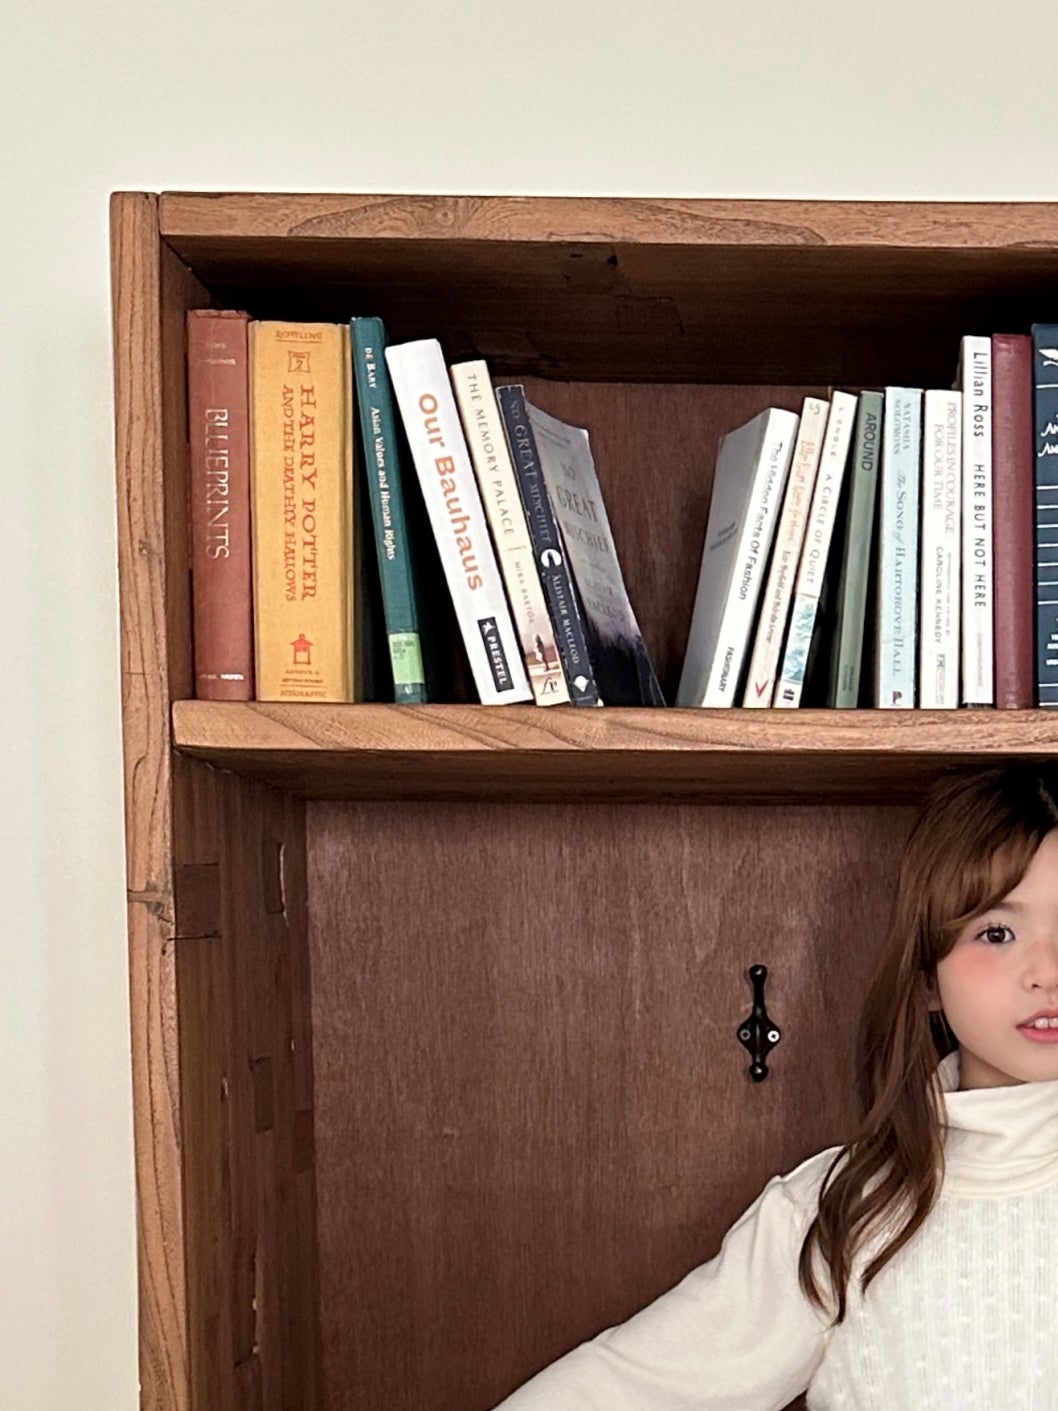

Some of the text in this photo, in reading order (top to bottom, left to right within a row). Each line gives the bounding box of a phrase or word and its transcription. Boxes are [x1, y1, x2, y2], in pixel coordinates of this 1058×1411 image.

[973, 351, 989, 438] Lillian Ross
[467, 373, 515, 535] THE MEMORY PALACE
[514, 424, 538, 478] GREAT
[769, 441, 783, 462] The
[861, 411, 877, 472] AROUND
[946, 401, 957, 457] PROFILES
[204, 408, 230, 559] BLUEPRINTS
[283, 385, 297, 602] AND THE DEATHLY HALLOWS
[300, 385, 319, 601] HARRY POTTER
[370, 406, 396, 561] Asian Values and Human Rights
[417, 392, 484, 591] Our Bauhaus
[932, 423, 945, 511] FOR OUR TIME
[752, 506, 768, 538] Facts
[816, 485, 832, 525] CIRCLE
[944, 473, 957, 534] COURAGE
[973, 463, 987, 608] HERE BUT NOT HERE
[551, 574, 570, 616] ALISTAIR
[738, 555, 757, 601] Fashion
[806, 548, 820, 584] QUIET
[934, 545, 944, 594] CAROLINE
[934, 598, 943, 644] KENNEDY
[486, 635, 507, 685] PRESTEL
